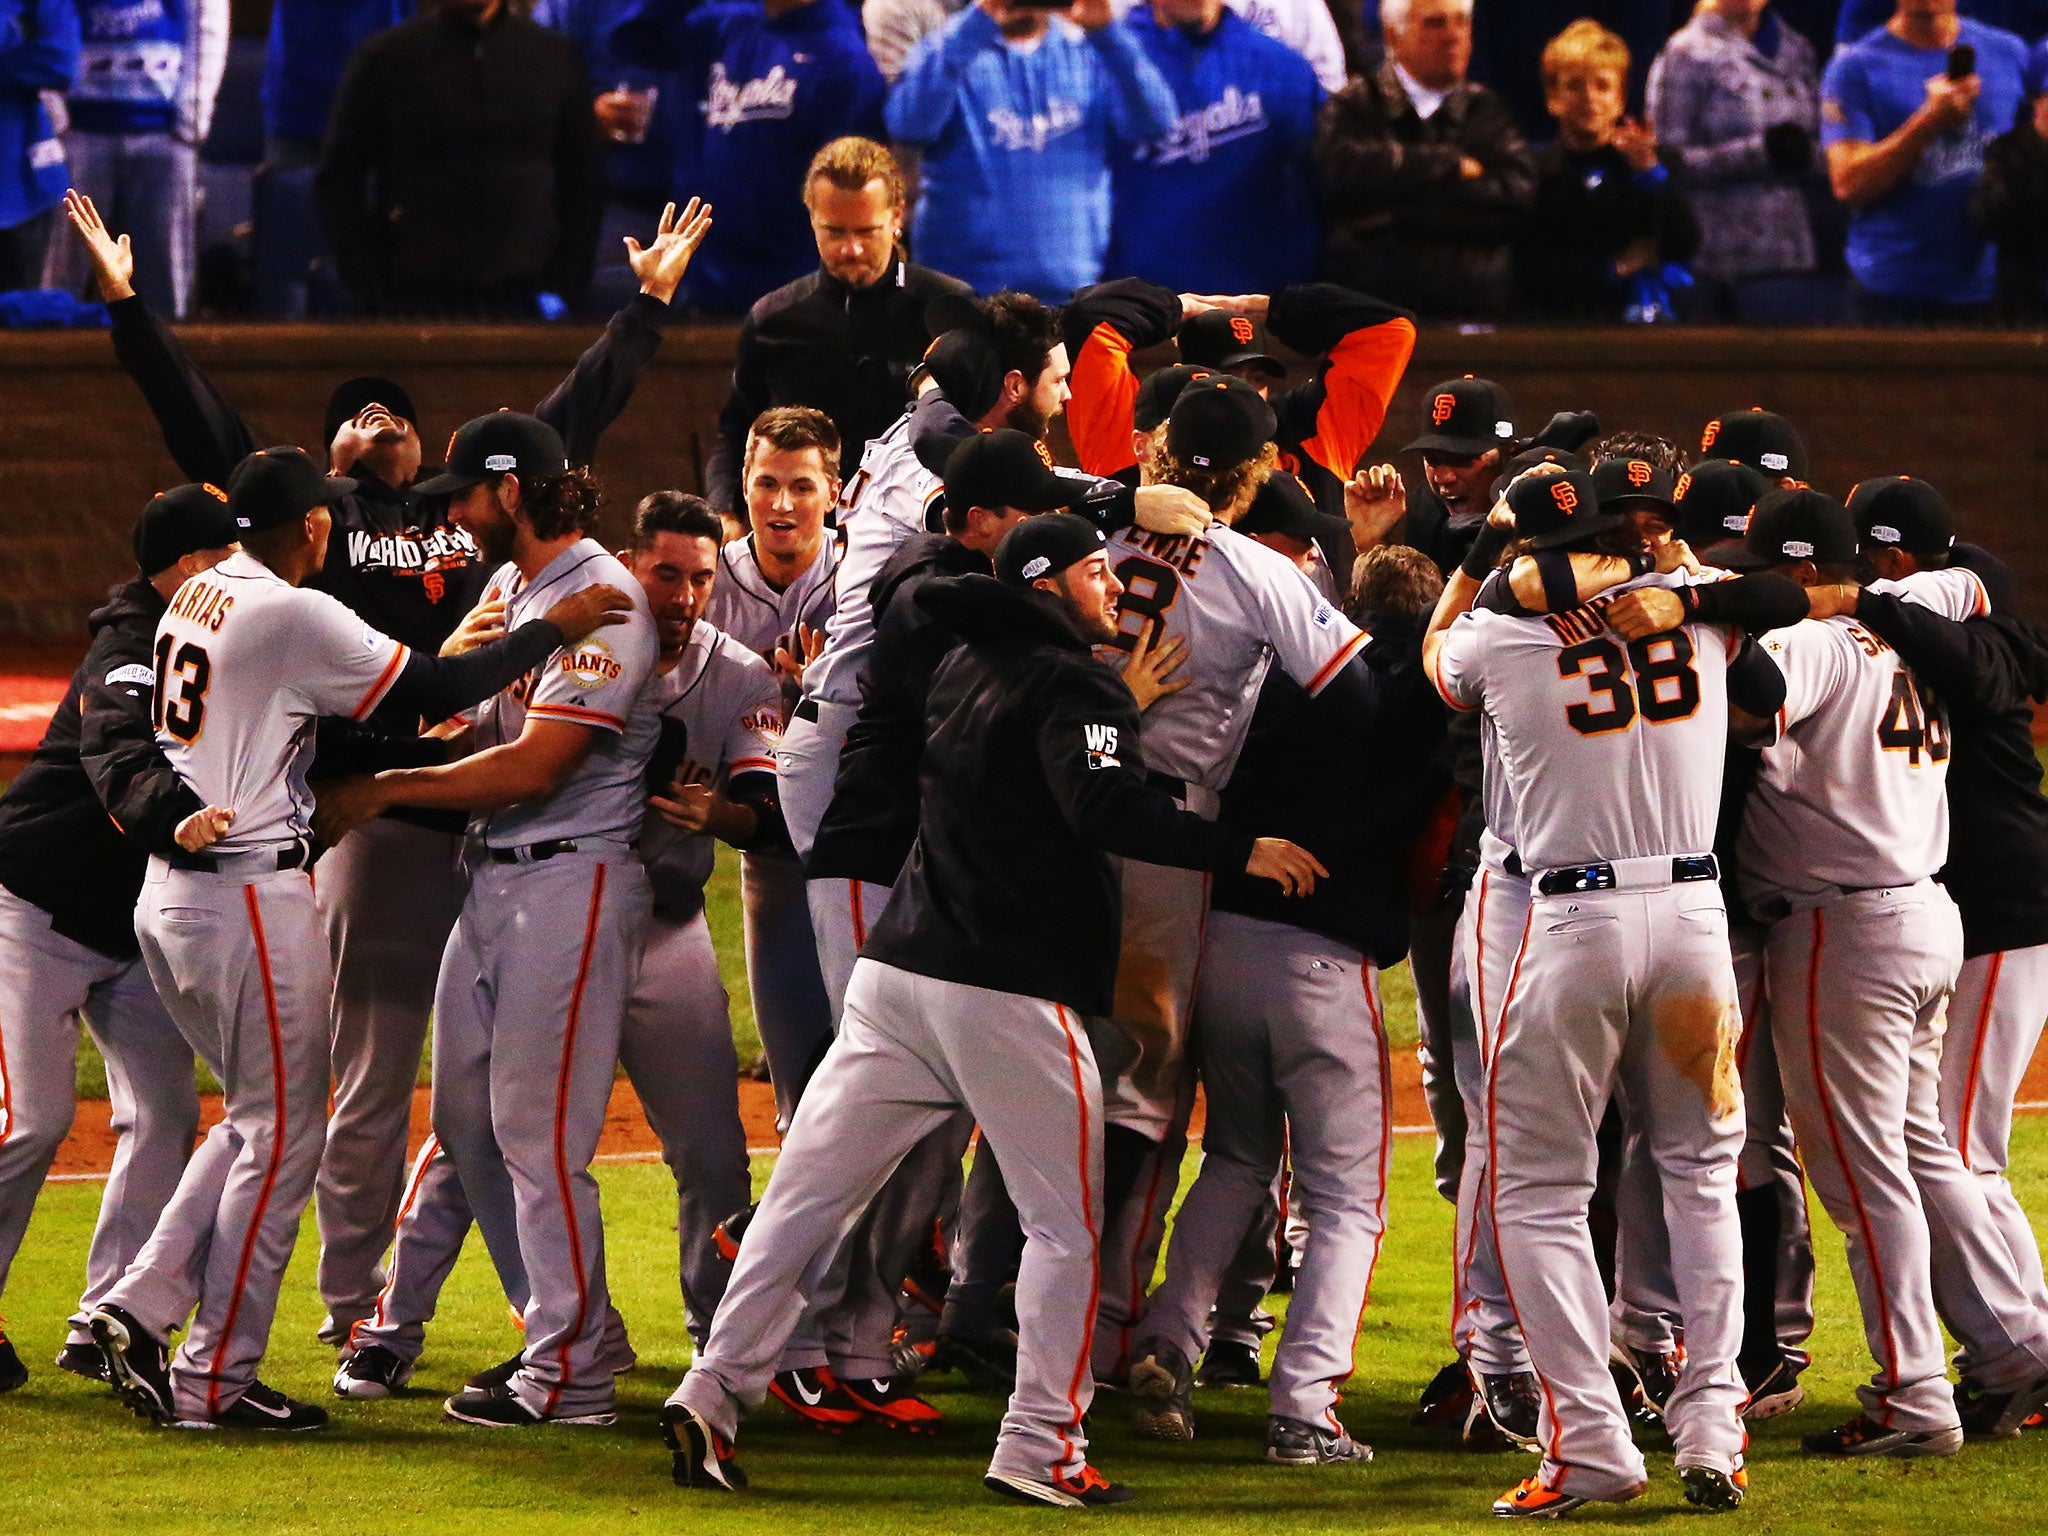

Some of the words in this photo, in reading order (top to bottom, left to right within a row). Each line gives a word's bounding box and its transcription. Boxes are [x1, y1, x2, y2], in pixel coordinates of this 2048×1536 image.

[348, 530, 422, 568] WORLD
[169, 580, 235, 634] ARIAS
[561, 653, 621, 679] GIANTS
[1557, 629, 1702, 740] 38
[153, 632, 211, 747] 13
[1084, 724, 1118, 754] WS
